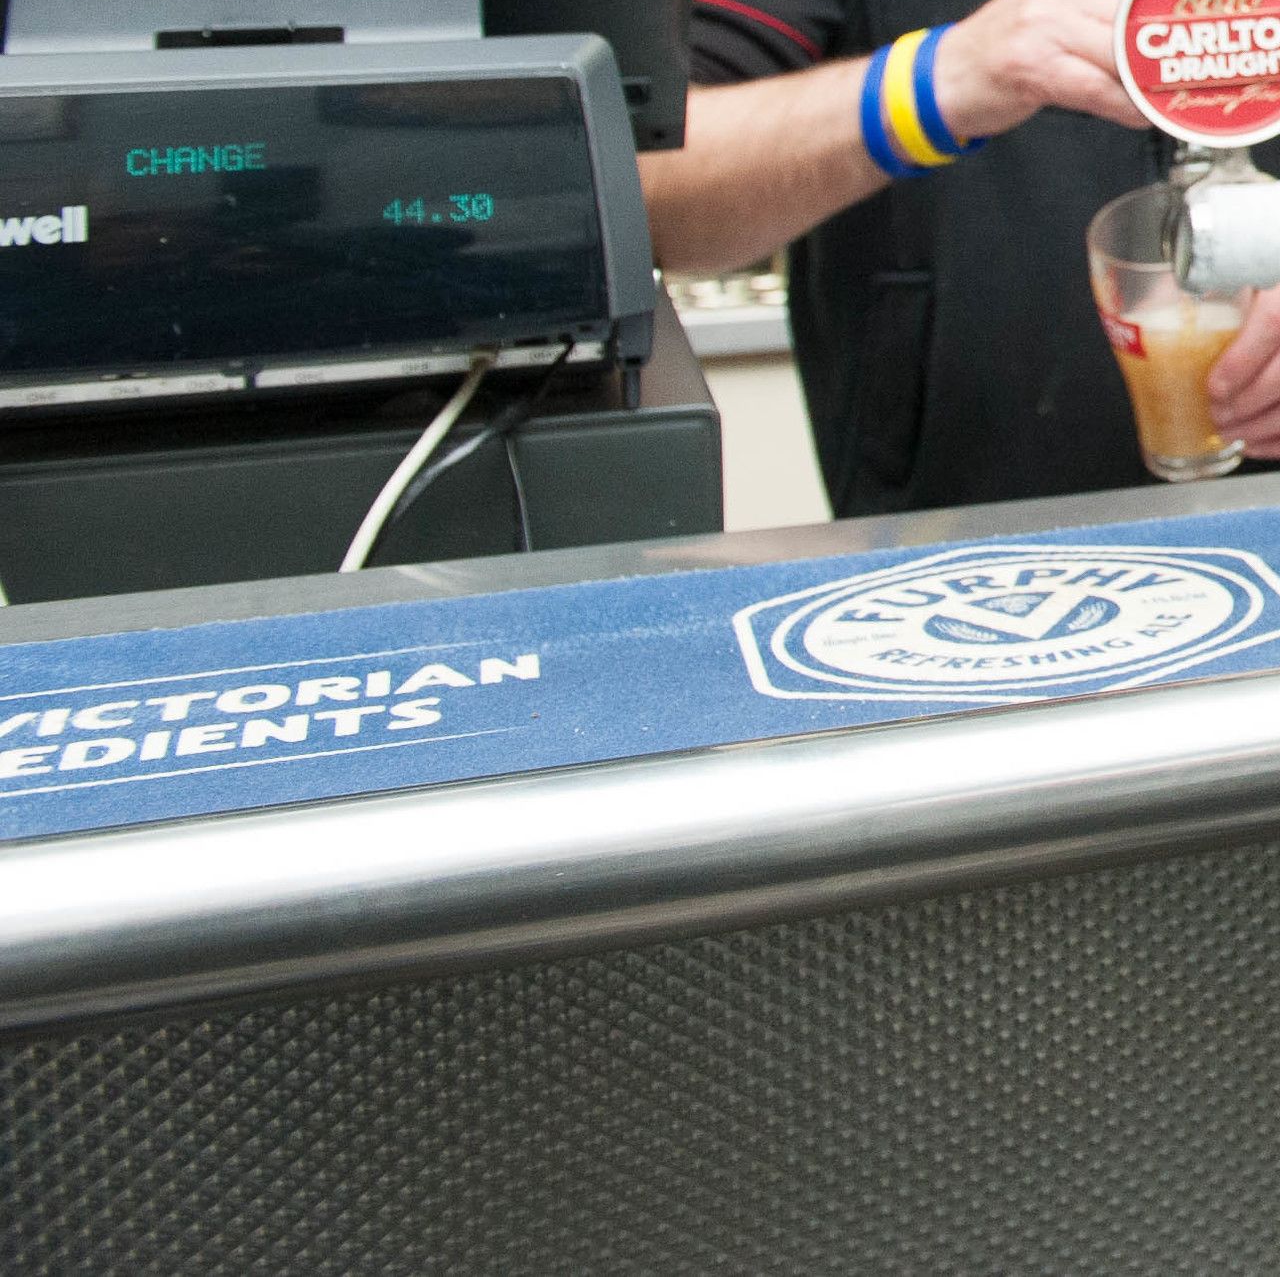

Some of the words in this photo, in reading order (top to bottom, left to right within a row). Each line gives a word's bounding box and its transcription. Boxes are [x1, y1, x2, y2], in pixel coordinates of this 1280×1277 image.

[126, 142, 267, 177] CHANGE
[382, 194, 495, 225] 44.30
[836, 567, 1184, 623] FURPHY
[868, 636, 1137, 670] REFRESHING
[1137, 611, 1193, 639] ALE
